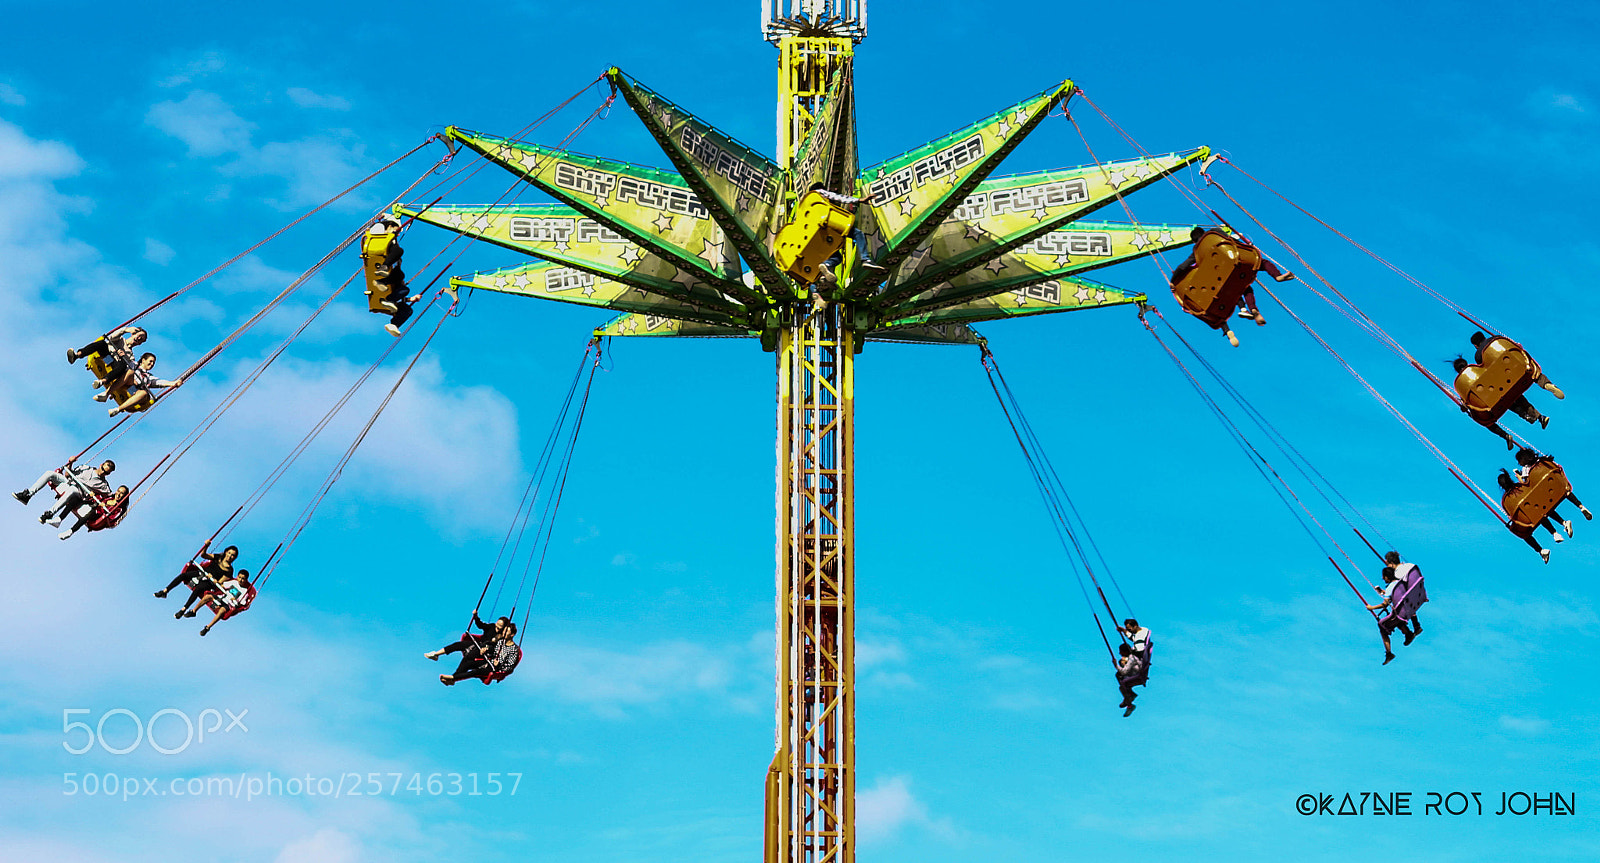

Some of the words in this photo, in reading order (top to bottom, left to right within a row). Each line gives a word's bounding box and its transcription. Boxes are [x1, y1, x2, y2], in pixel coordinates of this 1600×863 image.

[554, 161, 617, 198] SKY
[616, 176, 710, 220] FLYER
[680, 125, 719, 168] SKY
[715, 149, 778, 207] FLYER
[869, 166, 914, 207] SKY
[913, 133, 986, 188] FLYER
[989, 178, 1090, 217] FLYER
[510, 216, 575, 243] SKY
